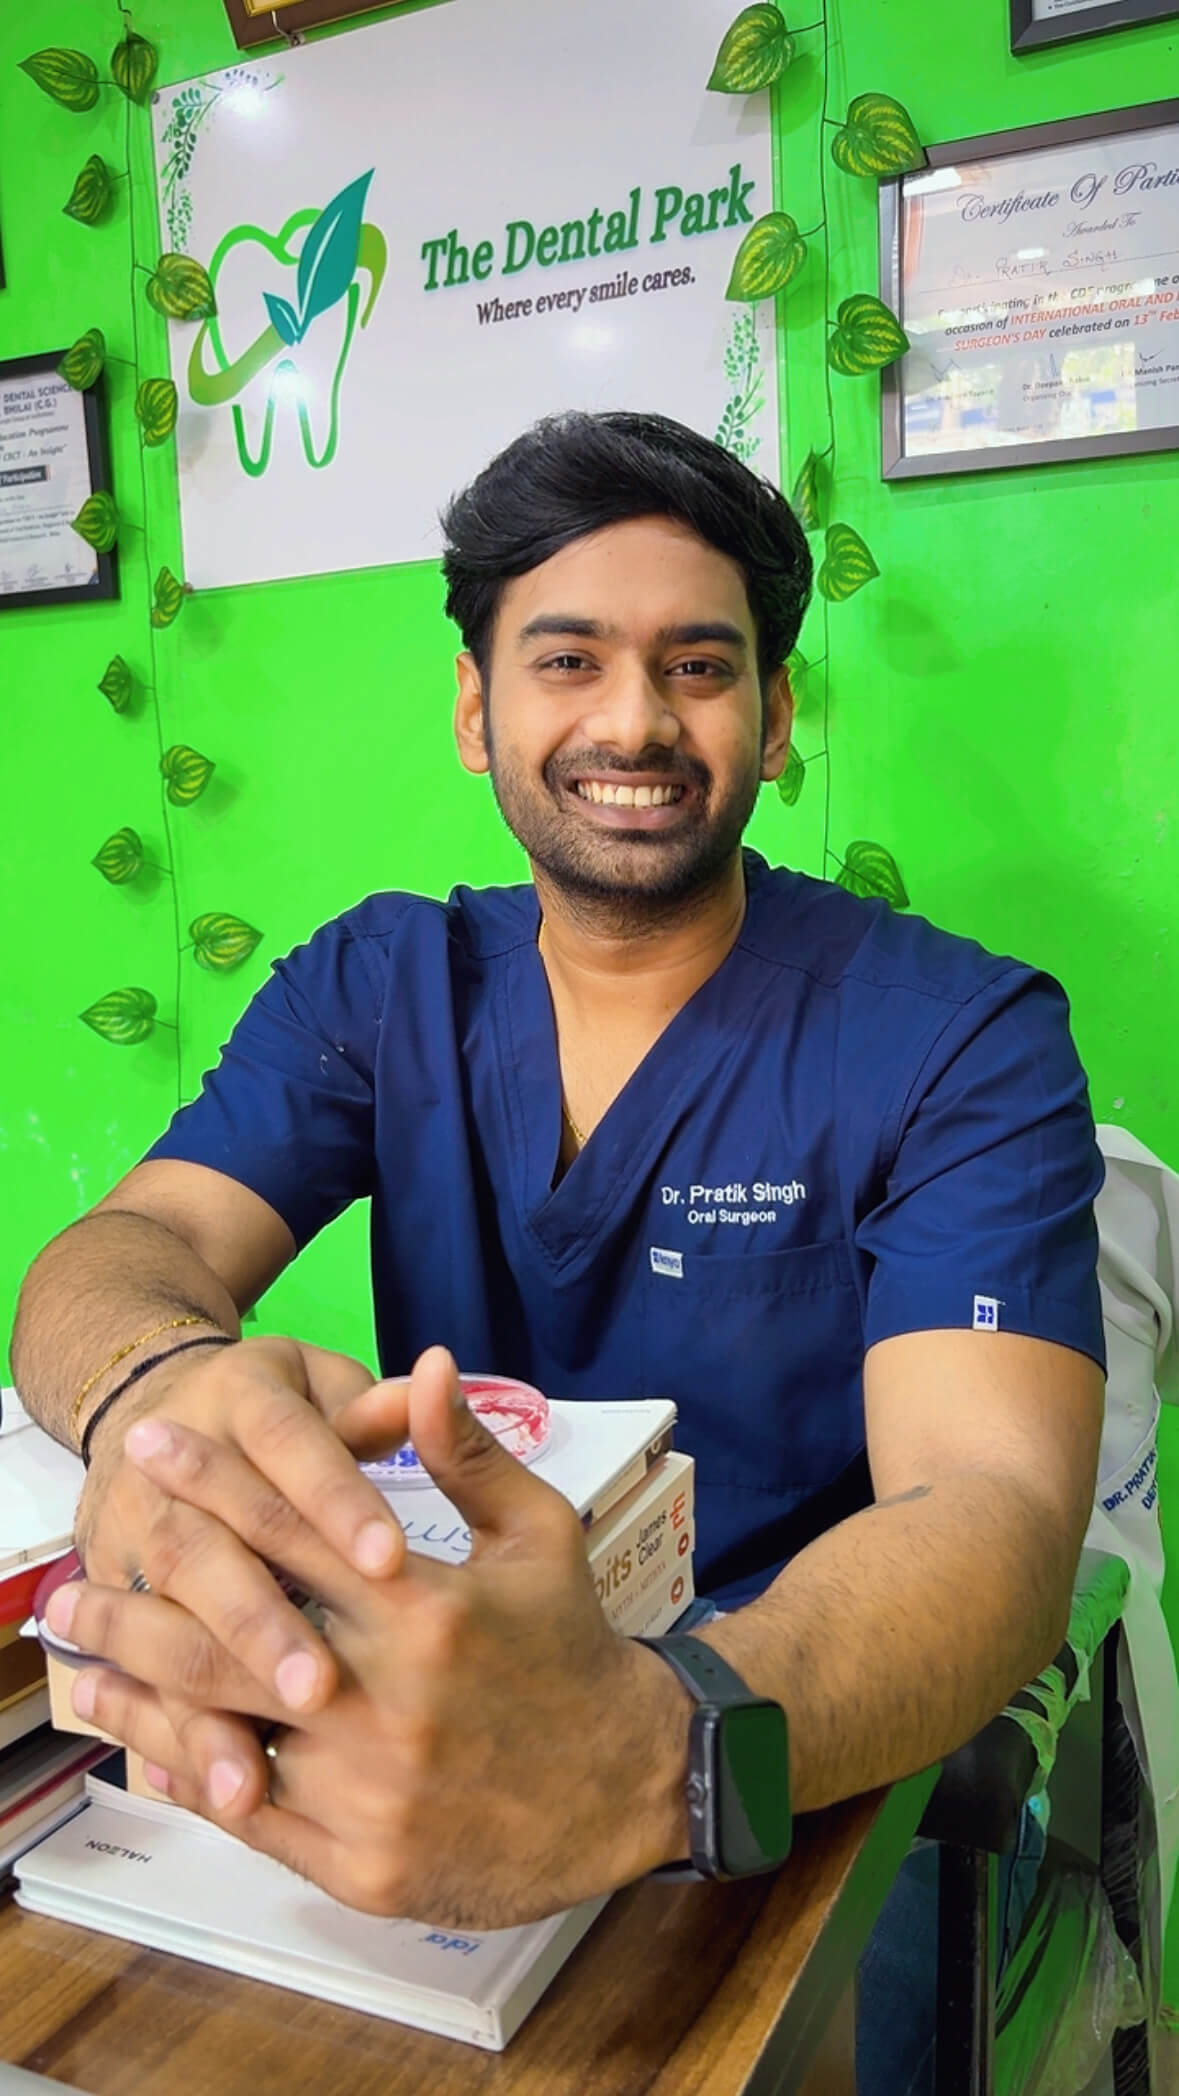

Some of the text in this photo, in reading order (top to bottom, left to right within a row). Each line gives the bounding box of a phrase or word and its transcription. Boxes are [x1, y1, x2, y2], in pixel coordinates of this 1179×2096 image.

[956, 188, 1060, 224] Certificate
[1070, 173, 1108, 210] Of
[421, 163, 755, 291] The Dental Park
[1062, 218, 1117, 238] Awarded
[476, 266, 696, 325] Where every smile cares.
[945, 292, 1174, 336] occasion of INTERNATIONAL ORAL AND
[954, 332, 1021, 351] SURGEON'S
[1023, 328, 1047, 342] DAY
[1049, 318, 1113, 338] celebrated
[1114, 318, 1131, 329] on
[661, 1186, 685, 1205] Dr.
[689, 1183, 748, 1205] Pratik
[687, 1208, 777, 1226] Oral Surgeon
[1102, 1491, 1128, 1511] DR.
[636, 1509, 667, 1548] James
[638, 1533, 663, 1566] Clear
